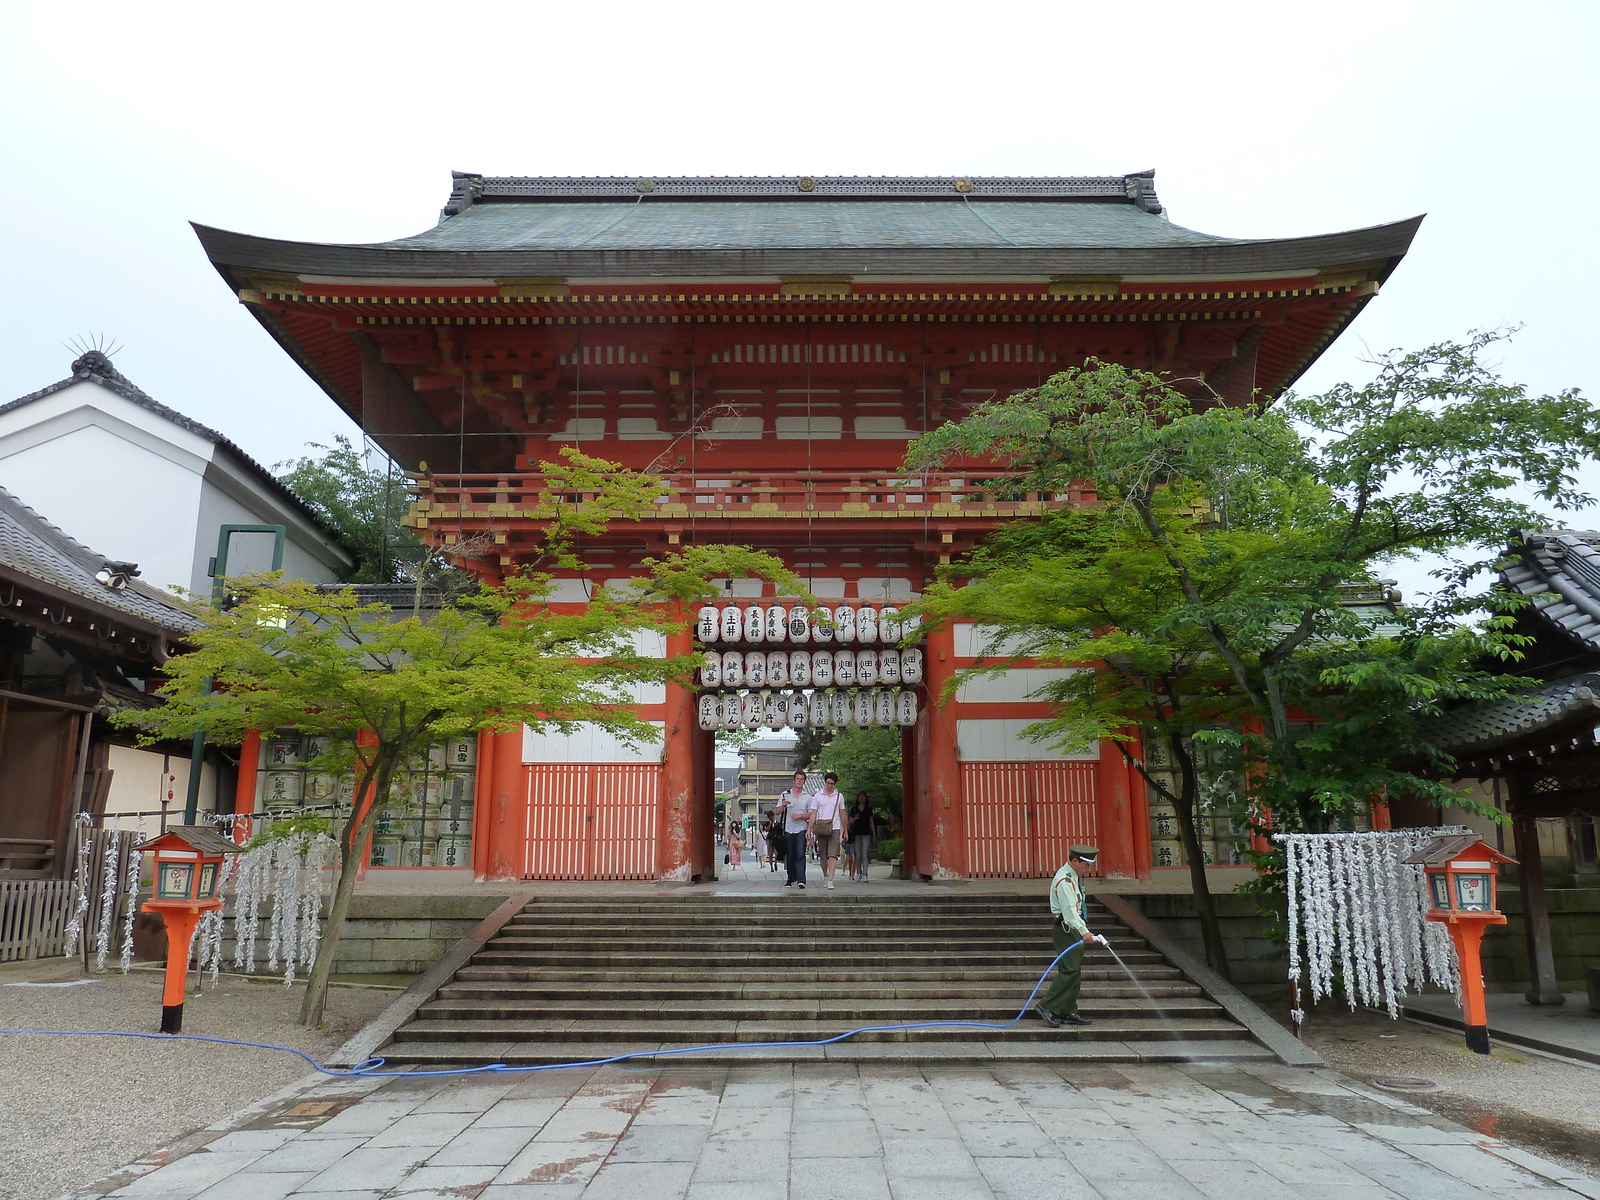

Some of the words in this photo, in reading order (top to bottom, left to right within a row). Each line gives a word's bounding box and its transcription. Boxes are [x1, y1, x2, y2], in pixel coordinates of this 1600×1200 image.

[815, 658, 829, 678] 畑中
[839, 660, 852, 681] 畑中
[859, 660, 873, 681] 畑中
[883, 657, 897, 677] 畑中
[903, 656, 916, 677] 畑中
